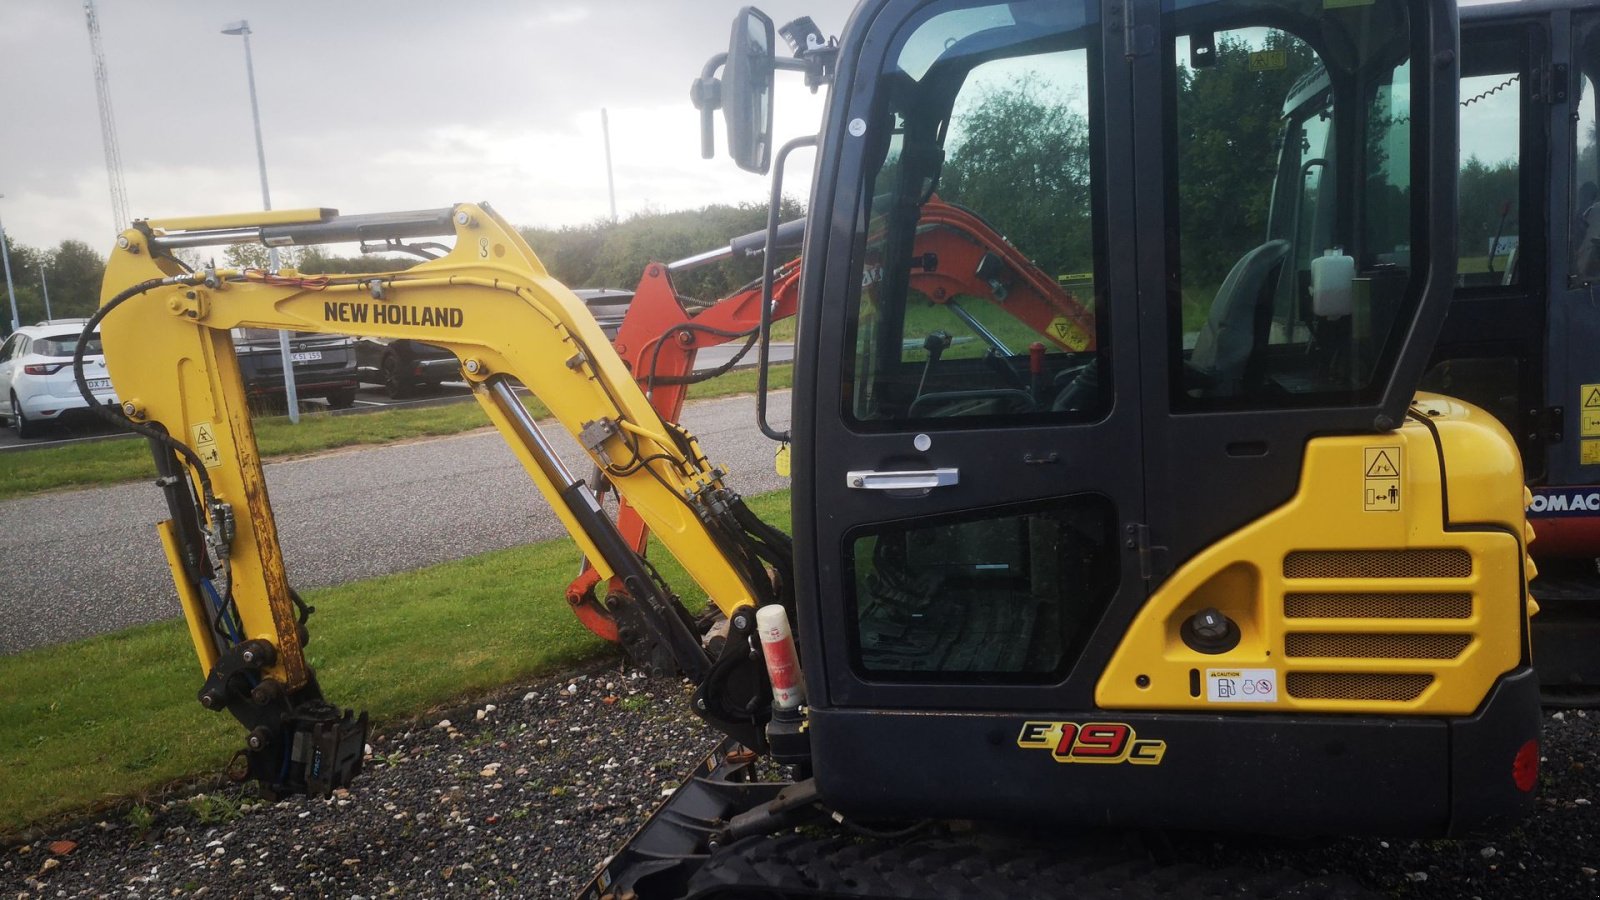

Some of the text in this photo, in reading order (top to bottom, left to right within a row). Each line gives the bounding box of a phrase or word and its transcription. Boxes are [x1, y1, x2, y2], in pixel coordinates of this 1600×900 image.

[324, 301, 464, 328] NEW HOLLAND
[1525, 493, 1600, 512] OMAC
